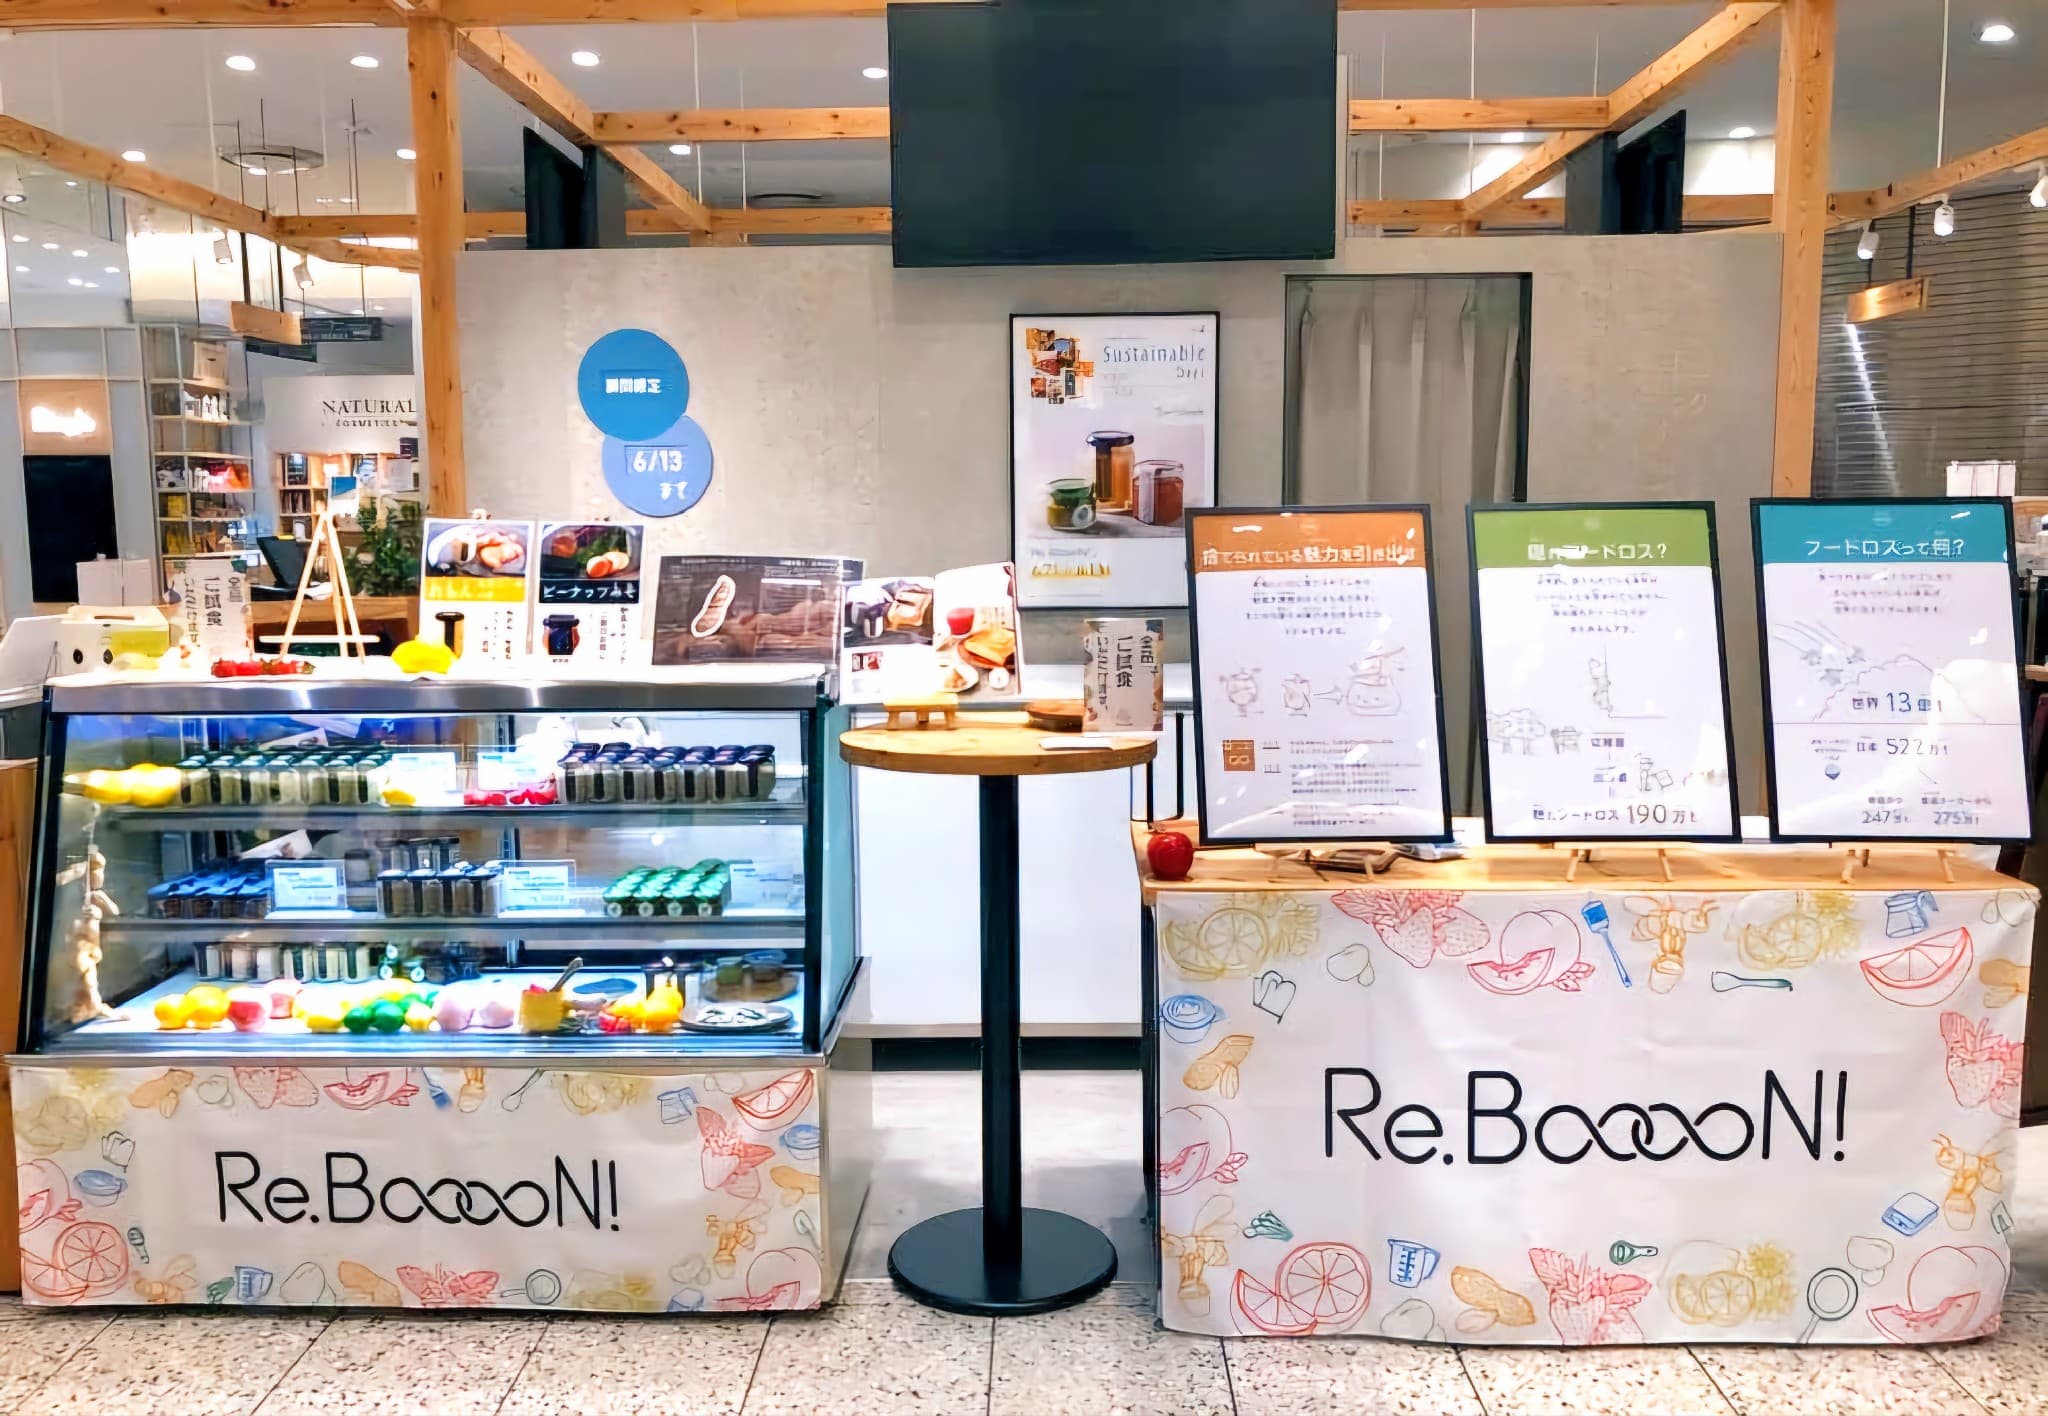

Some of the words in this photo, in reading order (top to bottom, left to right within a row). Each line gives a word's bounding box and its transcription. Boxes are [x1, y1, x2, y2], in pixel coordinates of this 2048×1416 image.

[1103, 343, 1206, 363] Sustainable
[322, 399, 417, 415] NATURAL
[633, 450, 684, 473] 6/13
